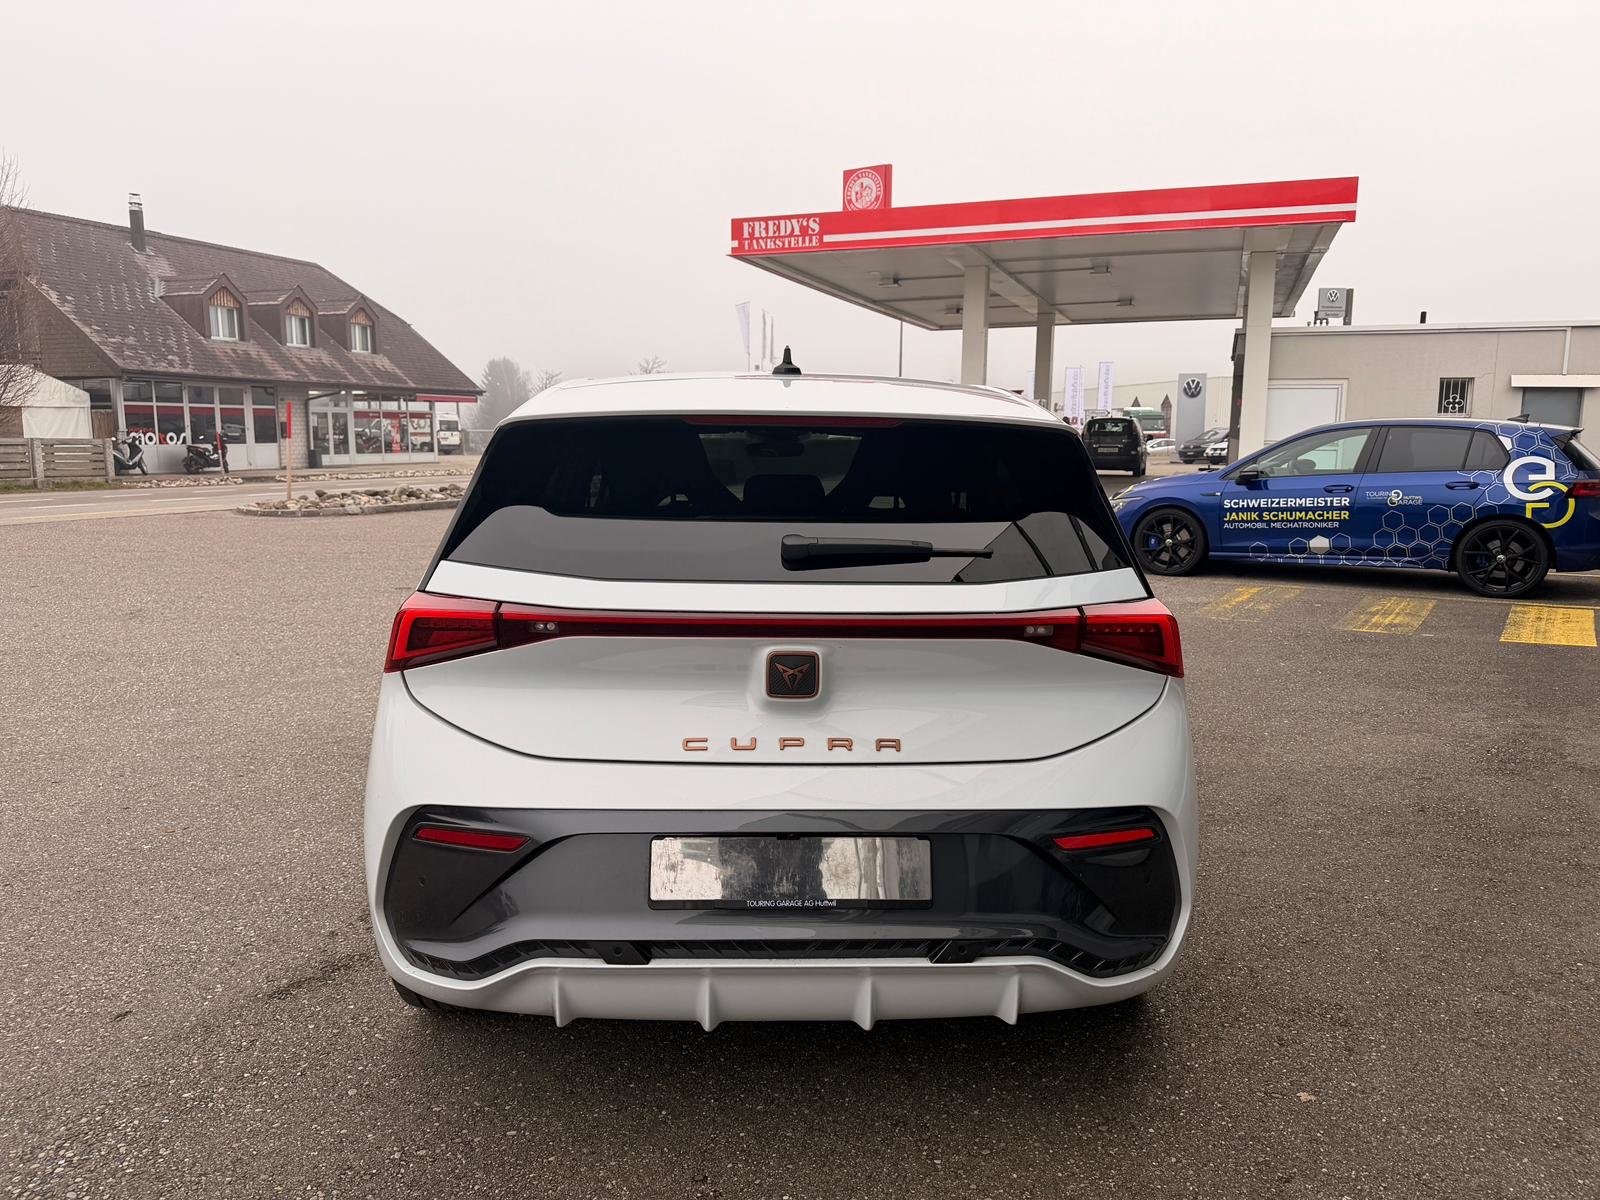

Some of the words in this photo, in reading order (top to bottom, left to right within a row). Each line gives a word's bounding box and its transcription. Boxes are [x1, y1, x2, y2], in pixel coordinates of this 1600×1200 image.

[742, 235, 820, 251] TANKSTELLE
[1223, 497, 1350, 508] SCHWEIZERMEISTER
[1223, 511, 1260, 521] JANIK
[1262, 510, 1350, 520] SCHUMACHER
[682, 737, 901, 752] CUPRA
[747, 900, 776, 908] TOURING
[776, 900, 803, 908] GARAGE
[803, 900, 814, 908] AG
[814, 900, 837, 908] Huttwil
